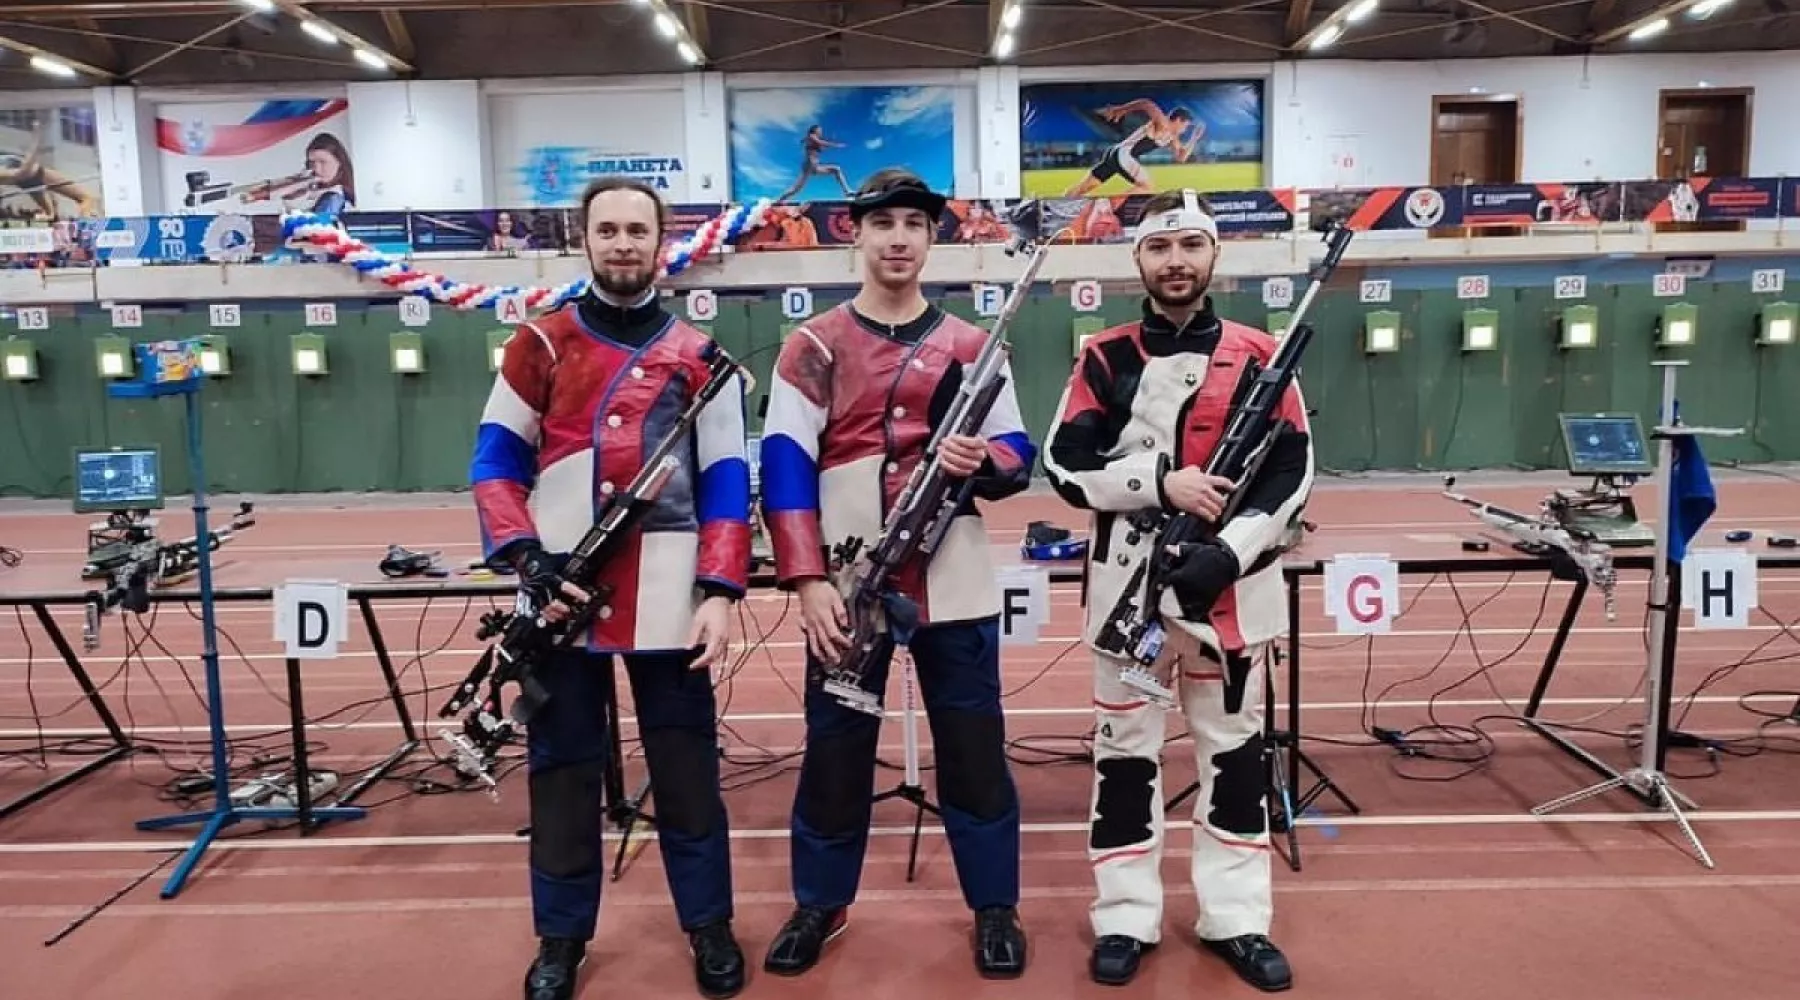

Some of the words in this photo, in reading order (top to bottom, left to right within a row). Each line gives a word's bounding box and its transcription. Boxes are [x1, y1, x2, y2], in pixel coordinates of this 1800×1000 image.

[587, 158, 683, 173] ПЛАНЕТА
[1462, 279, 1486, 296] 28
[1560, 279, 1582, 295] 29
[1657, 275, 1681, 292] 30
[1757, 272, 1777, 289] 31
[1079, 286, 1096, 306] G
[1364, 283, 1387, 299] 27
[505, 298, 519, 320] A
[694, 295, 708, 315] C
[790, 292, 805, 313] D
[982, 289, 997, 312] F
[22, 311, 44, 327] 13
[117, 308, 138, 324] 14
[214, 308, 235, 323] 15
[313, 306, 332, 321] 16
[1346, 574, 1384, 623] G
[1702, 570, 1733, 617] H
[1004, 588, 1030, 635] F
[297, 601, 329, 648] D
